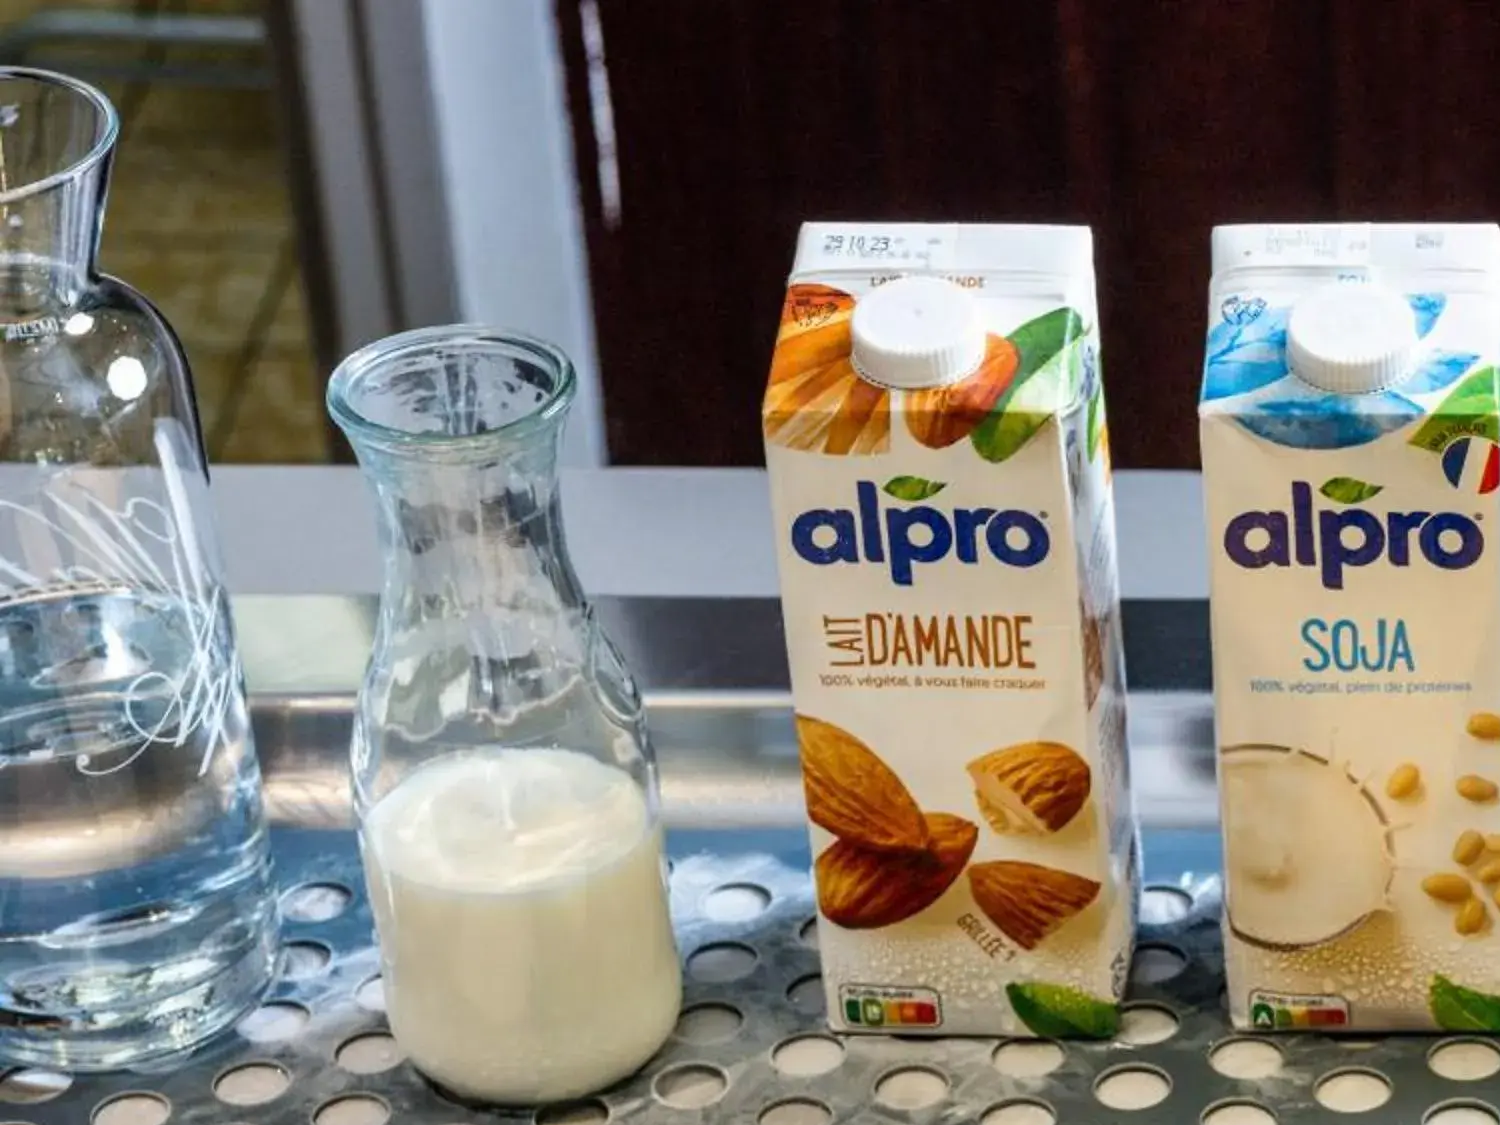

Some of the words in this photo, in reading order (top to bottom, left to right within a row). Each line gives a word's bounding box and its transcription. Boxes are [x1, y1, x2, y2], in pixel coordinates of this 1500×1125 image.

[791, 480, 1050, 586] alpro
[1224, 481, 1484, 590] alpro
[823, 615, 865, 667] LAIT
[865, 612, 1036, 669] D'AMANDE
[1301, 618, 1414, 672] SOJA
